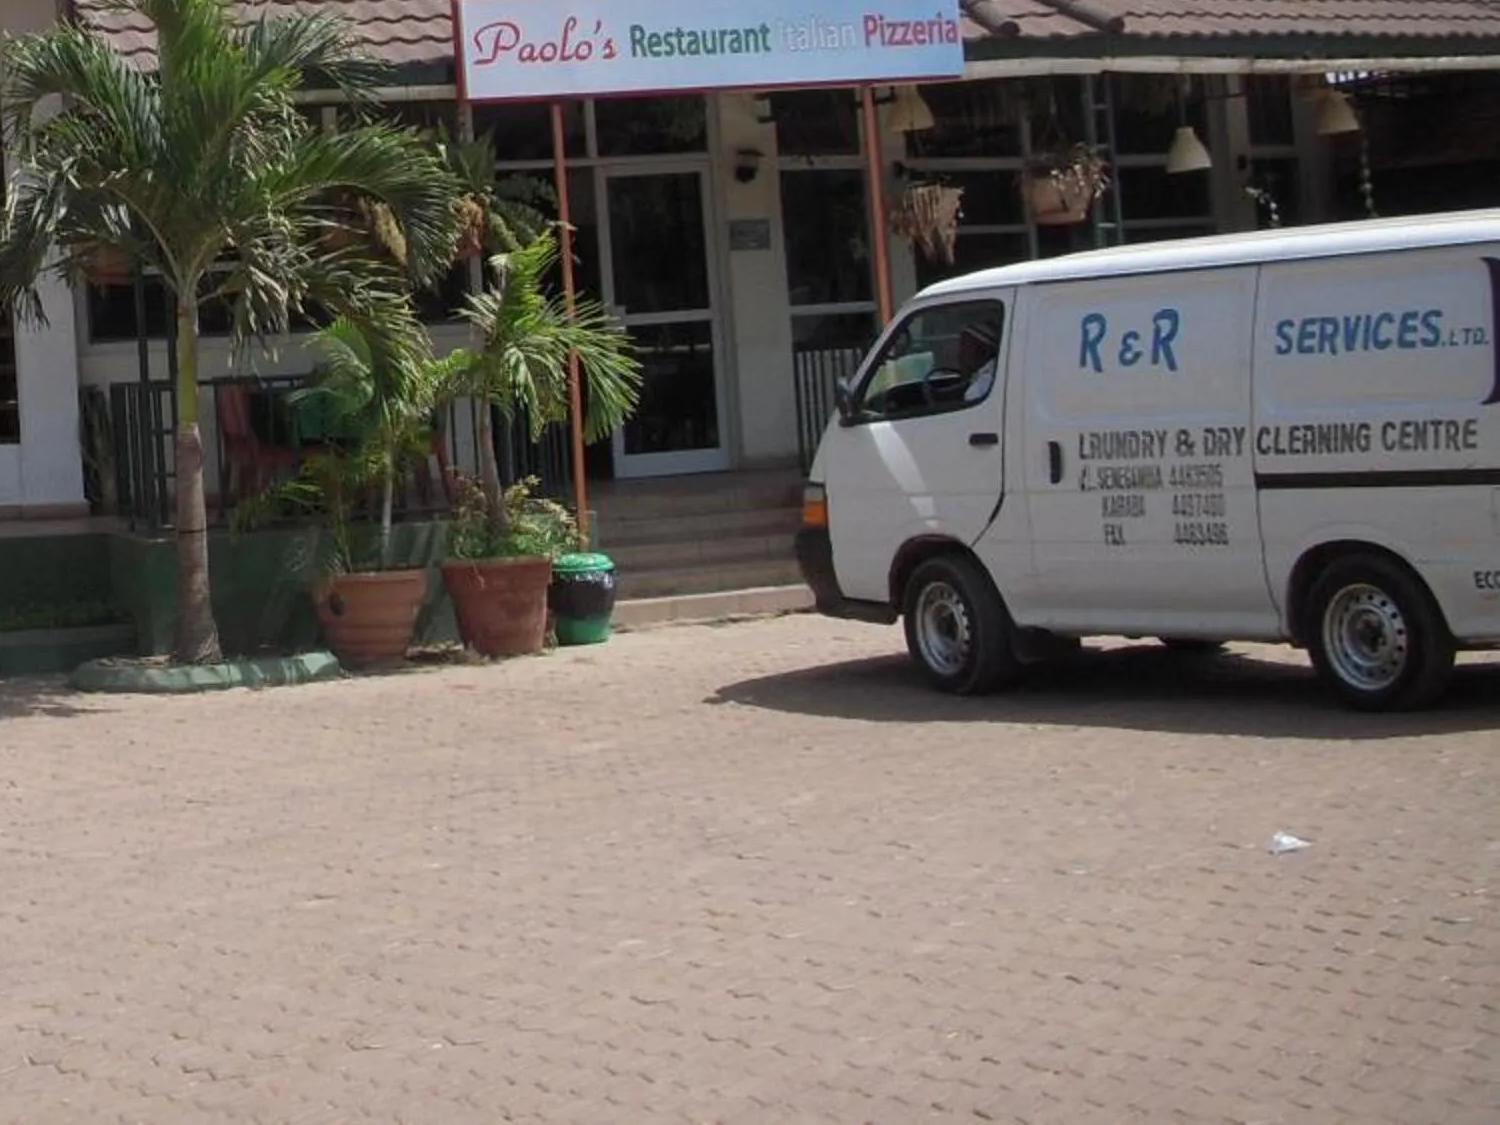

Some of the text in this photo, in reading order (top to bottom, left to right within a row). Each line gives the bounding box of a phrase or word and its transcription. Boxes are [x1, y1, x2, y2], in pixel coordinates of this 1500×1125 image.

[473, 16, 617, 65] Paolo's
[630, 22, 771, 57] Restaurant
[863, 11, 958, 47] Pizzeria
[1079, 312, 1107, 373] R
[1151, 308, 1180, 372] R
[1078, 418, 1479, 460] LAUNDRY & DRY CLEANING CENTRE
